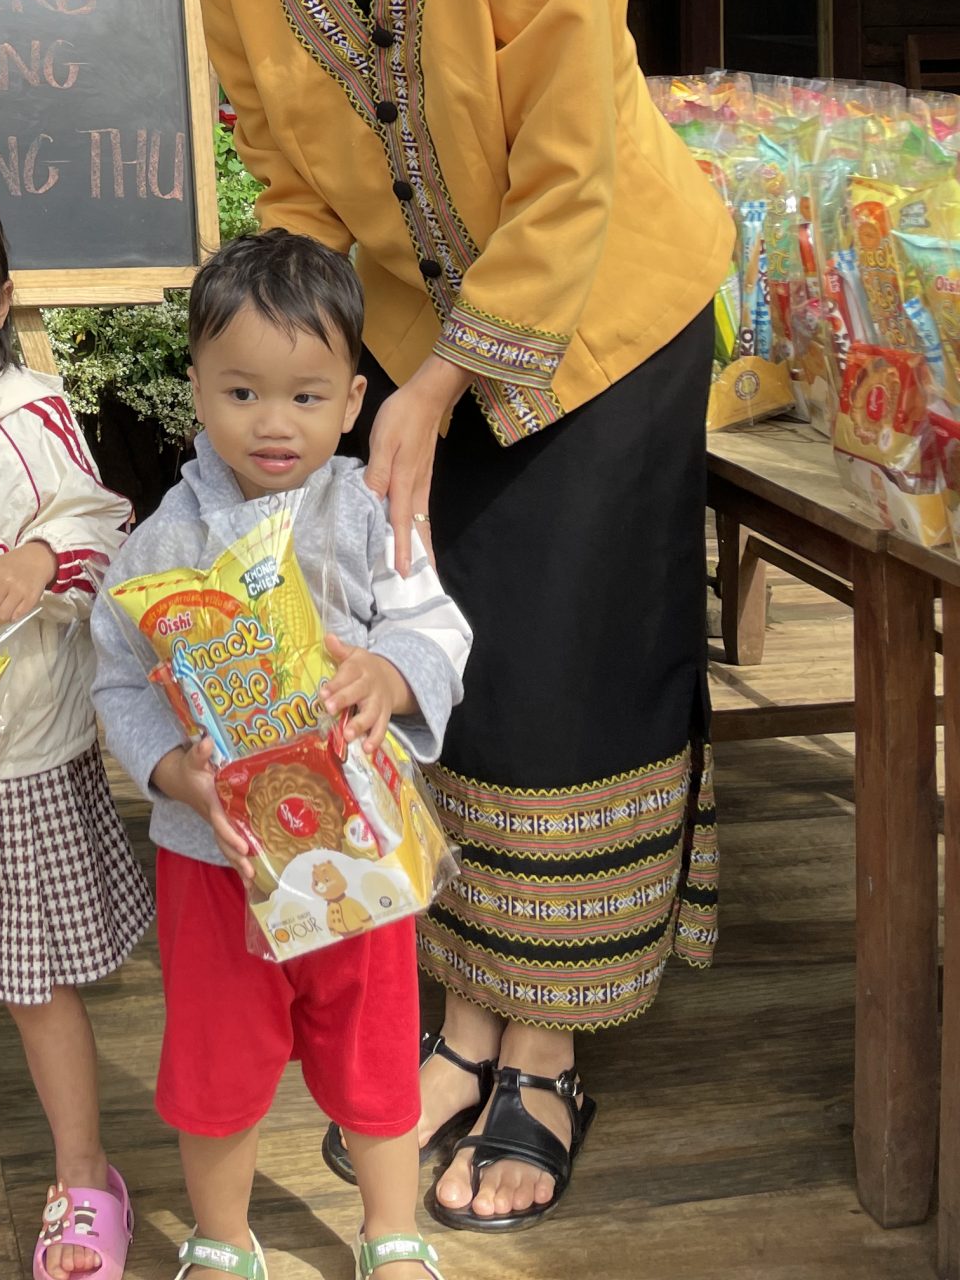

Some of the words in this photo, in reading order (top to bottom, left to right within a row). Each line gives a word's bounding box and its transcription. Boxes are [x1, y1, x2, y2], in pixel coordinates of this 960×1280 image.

[76, 128, 185, 201] THU
[157, 612, 192, 636] Oishi
[193, 1245, 239, 1267] SPORT
